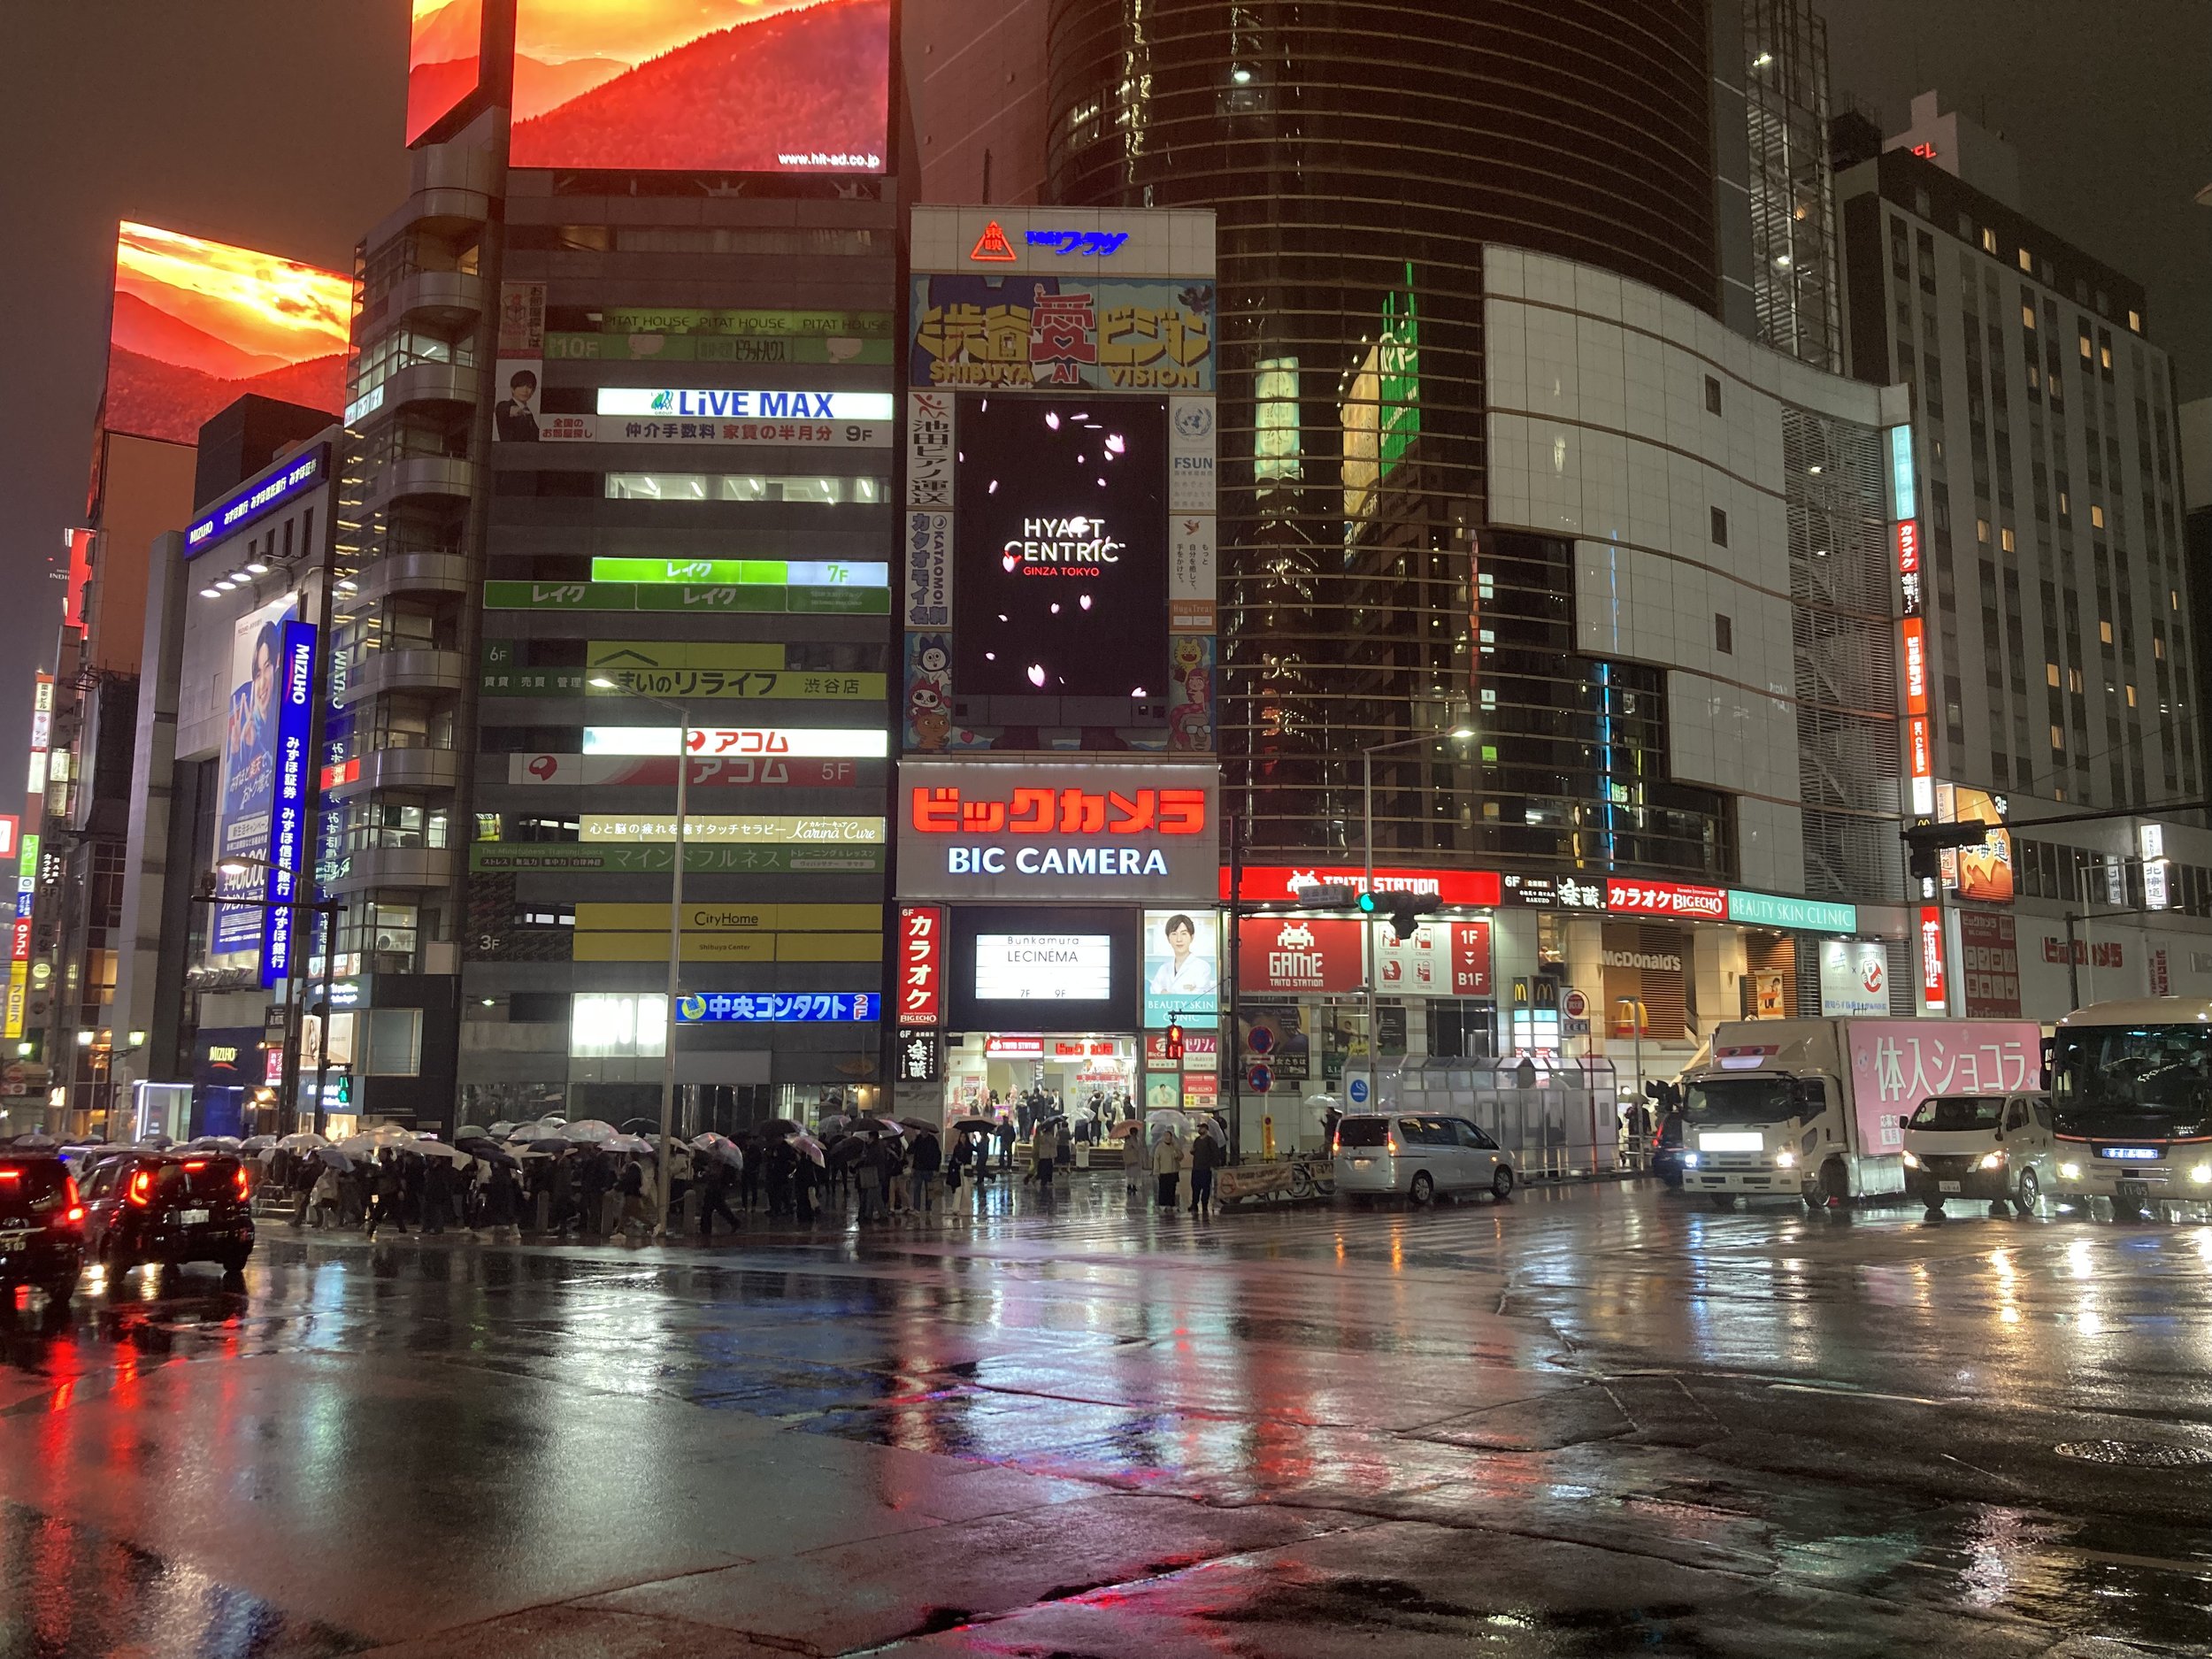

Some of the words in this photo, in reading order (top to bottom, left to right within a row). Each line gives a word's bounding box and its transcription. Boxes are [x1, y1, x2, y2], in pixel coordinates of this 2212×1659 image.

[778, 152, 880, 169] www.hit-ad.co.jp
[984, 227, 1002, 250] 東映
[604, 315, 638, 327] PITAT
[643, 316, 690, 327] HOUSE
[700, 317, 735, 328] PITAT
[739, 318, 786, 328] HOUSE
[803, 319, 838, 329] PITAT
[841, 319, 891, 330] HOUSE
[558, 337, 599, 358] 10F
[929, 362, 1034, 385] SHIBUYA
[1051, 364, 1079, 383] AI
[1108, 365, 1201, 388] VISION
[759, 392, 834, 418] MAX
[553, 419, 584, 428] 全国の
[625, 422, 716, 440] 仲介手数料
[723, 424, 833, 442] 家賃の半月分
[845, 425, 873, 442] 9F
[542, 428, 594, 439] お部屋探し
[911, 419, 949, 505] 池田ピアノ運送
[1174, 457, 1212, 469] FSUN
[189, 519, 214, 545] MIZUHO
[1901, 526, 1915, 569] カラオケ
[666, 562, 712, 577] レイク
[826, 565, 849, 582] 7F
[933, 531, 945, 605] KATAOMOI
[1023, 566, 1058, 576] GINZA
[1061, 566, 1100, 577] TOKYO
[532, 585, 586, 603] レイク
[684, 588, 737, 605] レイク
[489, 647, 507, 662] 6F
[292, 643, 310, 705] MIZUHO
[557, 677, 581, 688] 管理
[804, 677, 860, 695] 渋谷店
[715, 731, 789, 752] アコム
[283, 736, 300, 799] みずほ証券
[694, 757, 789, 783] アコム
[821, 764, 851, 780] 5F
[913, 787, 1204, 833] ビックカメラ
[1994, 795, 2008, 815] 3F
[843, 821, 876, 839] Cure
[548, 848, 580, 857] Training
[613, 849, 781, 868] マインドフルネス
[949, 847, 1007, 874] BIC
[1015, 848, 1169, 875] CAMERA
[1373, 877, 1440, 895] STATION
[1504, 876, 1521, 887] 6F
[1610, 887, 1673, 909] カラオケ
[1732, 899, 1774, 919] BEAUTY
[1778, 904, 1804, 922] SKIN
[1807, 908, 1853, 928] CLINIC
[16, 934, 27, 956] アコム
[271, 907, 288, 969] みずほ銀行
[480, 935, 500, 950] 3F
[1007, 935, 1079, 946] Bunkamura
[1461, 930, 1478, 945] 1F
[906, 915, 933, 1010] カラオケ
[1269, 952, 1324, 978] GAME
[1601, 949, 1681, 972] McDonald's
[1270, 978, 1290, 987] TAITO
[1292, 978, 1324, 987] STATION
[1457, 972, 1483, 987] B1F
[1020, 988, 1031, 998] 7F
[1055, 988, 1067, 998] 9F
[709, 995, 847, 1019] 中央コンタクト
[853, 995, 868, 1019] 2F
[1148, 1000, 1187, 1010] BEAUTY
[1187, 1000, 1215, 1010] SKIN
[899, 1030, 911, 1039] 6F
[209, 1046, 235, 1062] MIZUHO
[1873, 1037, 2027, 1102] 体入ショコラ
